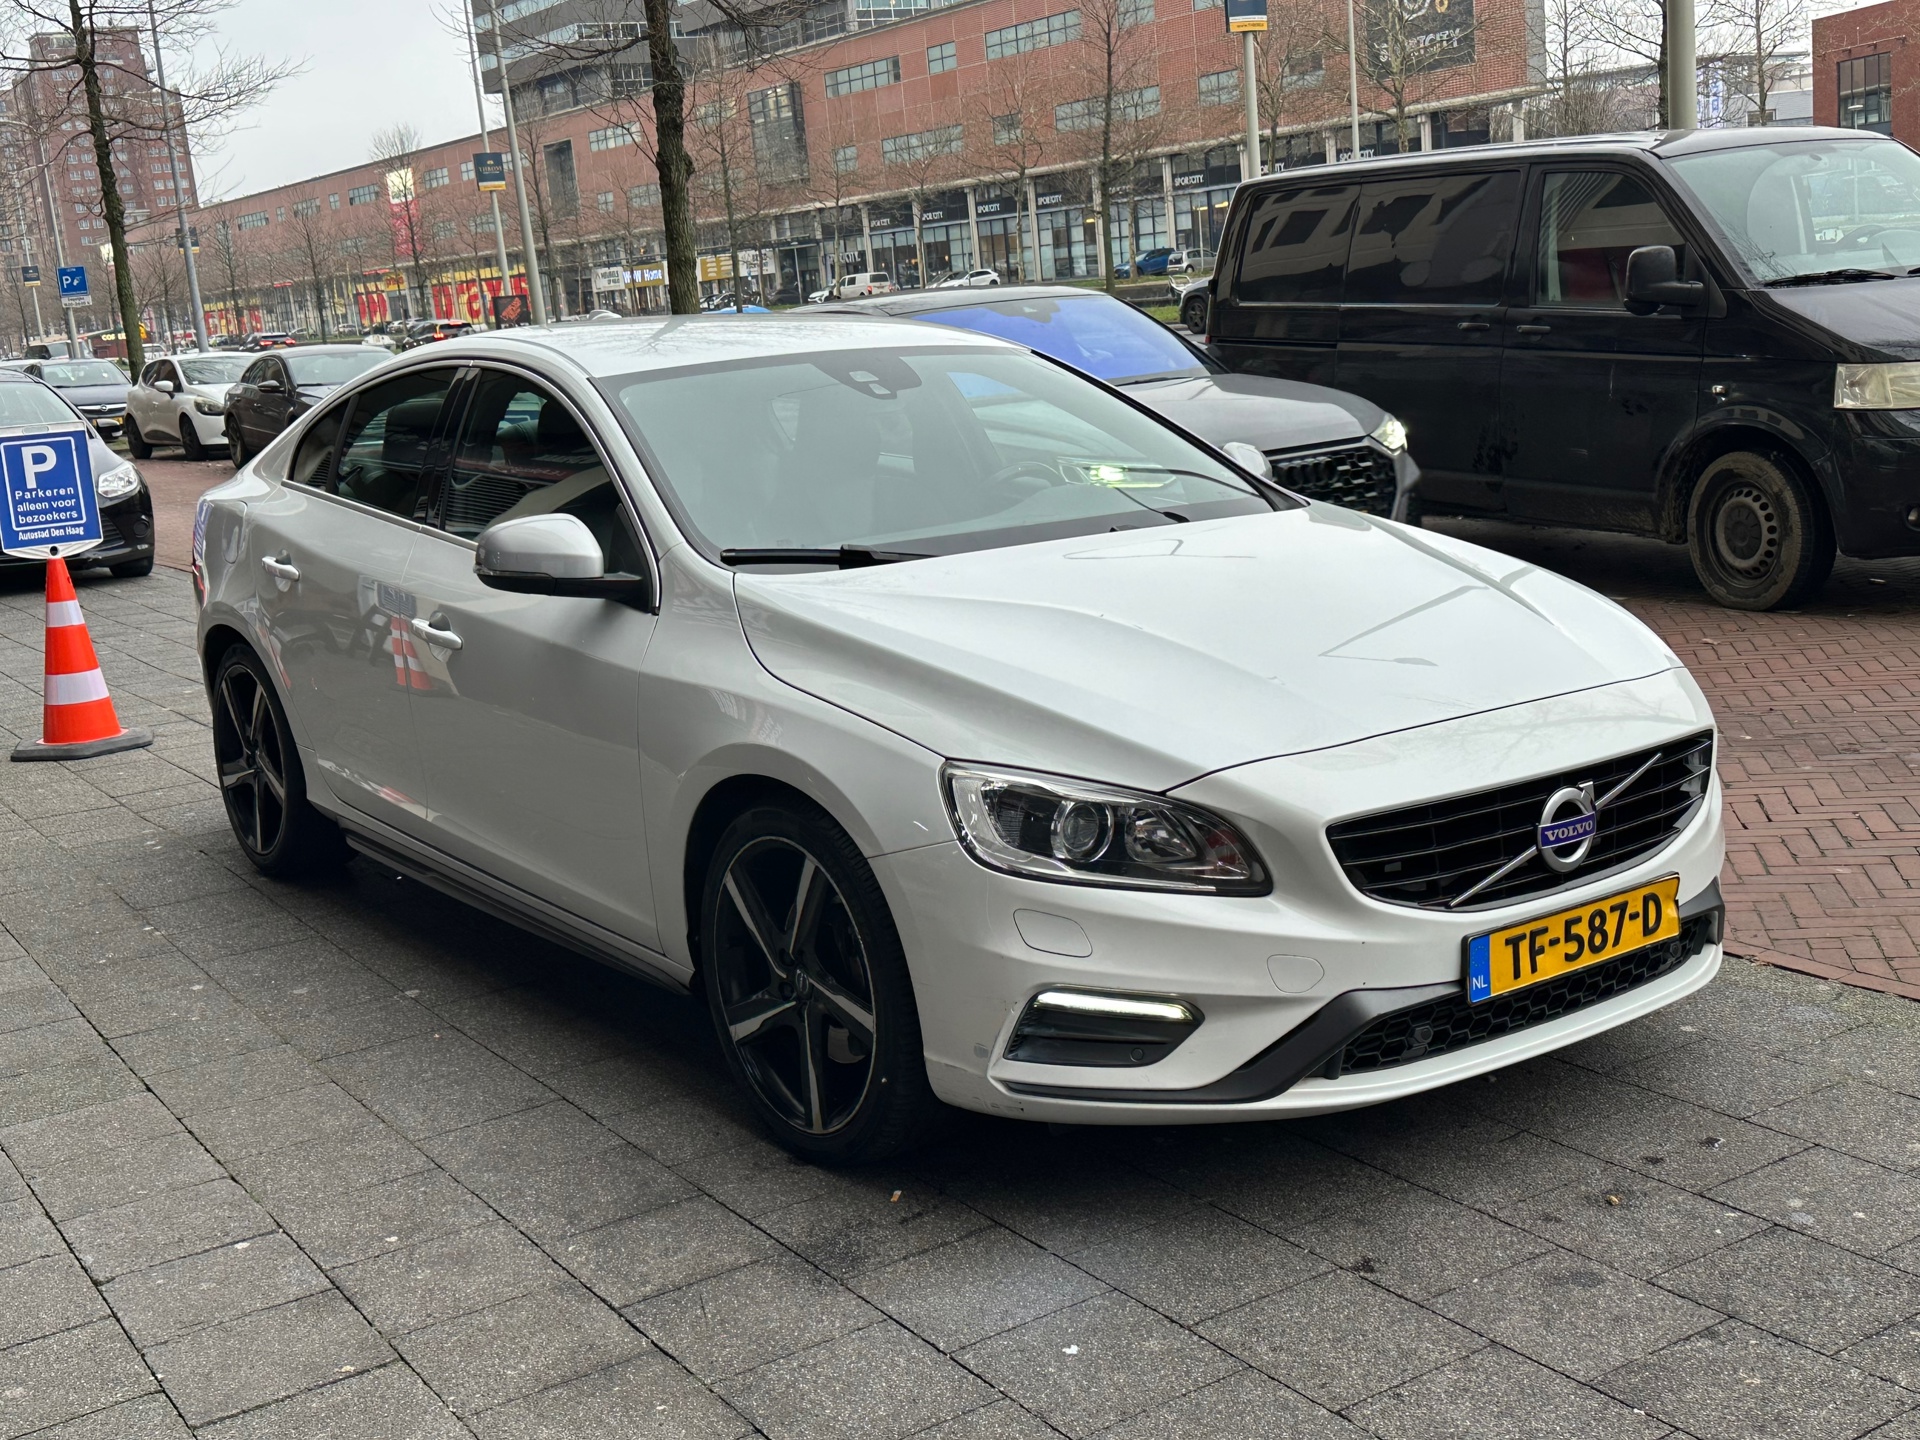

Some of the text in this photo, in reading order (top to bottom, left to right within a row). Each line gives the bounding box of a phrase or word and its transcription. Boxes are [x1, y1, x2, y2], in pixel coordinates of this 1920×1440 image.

[1340, 149, 1375, 161] SPOCITY
[622, 270, 641, 284] WW
[643, 268, 662, 282] Home
[21, 445, 57, 489] P
[15, 486, 74, 500] Parkeren
[17, 498, 76, 512] alleen voor
[18, 510, 78, 524] bezoekers
[18, 525, 84, 541] Autostad Den Haag
[1544, 820, 1593, 841] VOLVO
[1505, 892, 1663, 981] TF-587-D
[1472, 975, 1488, 991] NL
